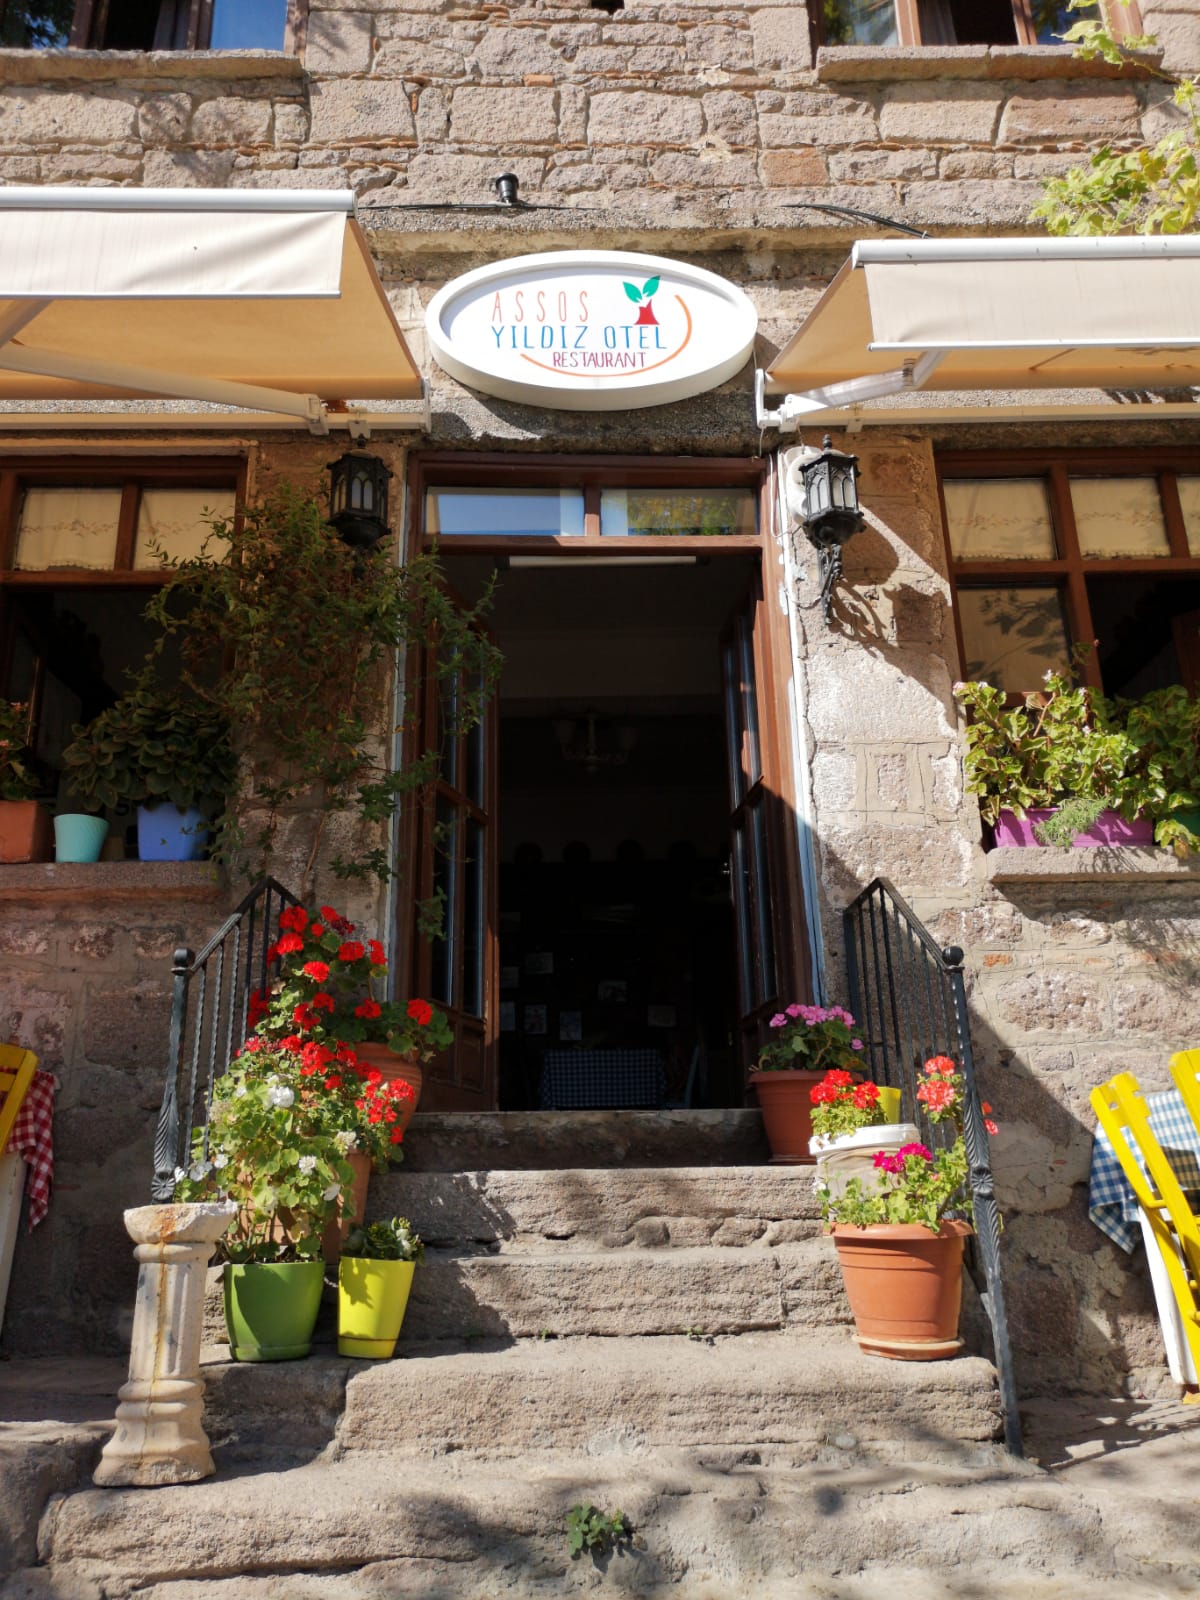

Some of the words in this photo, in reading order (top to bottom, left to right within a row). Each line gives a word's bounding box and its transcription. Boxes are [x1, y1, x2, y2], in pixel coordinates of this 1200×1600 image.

[492, 291, 589, 322] ASSOS
[491, 325, 588, 349] YILDIZ
[603, 325, 667, 349] OTEL
[552, 351, 647, 368] RESTAURANT
